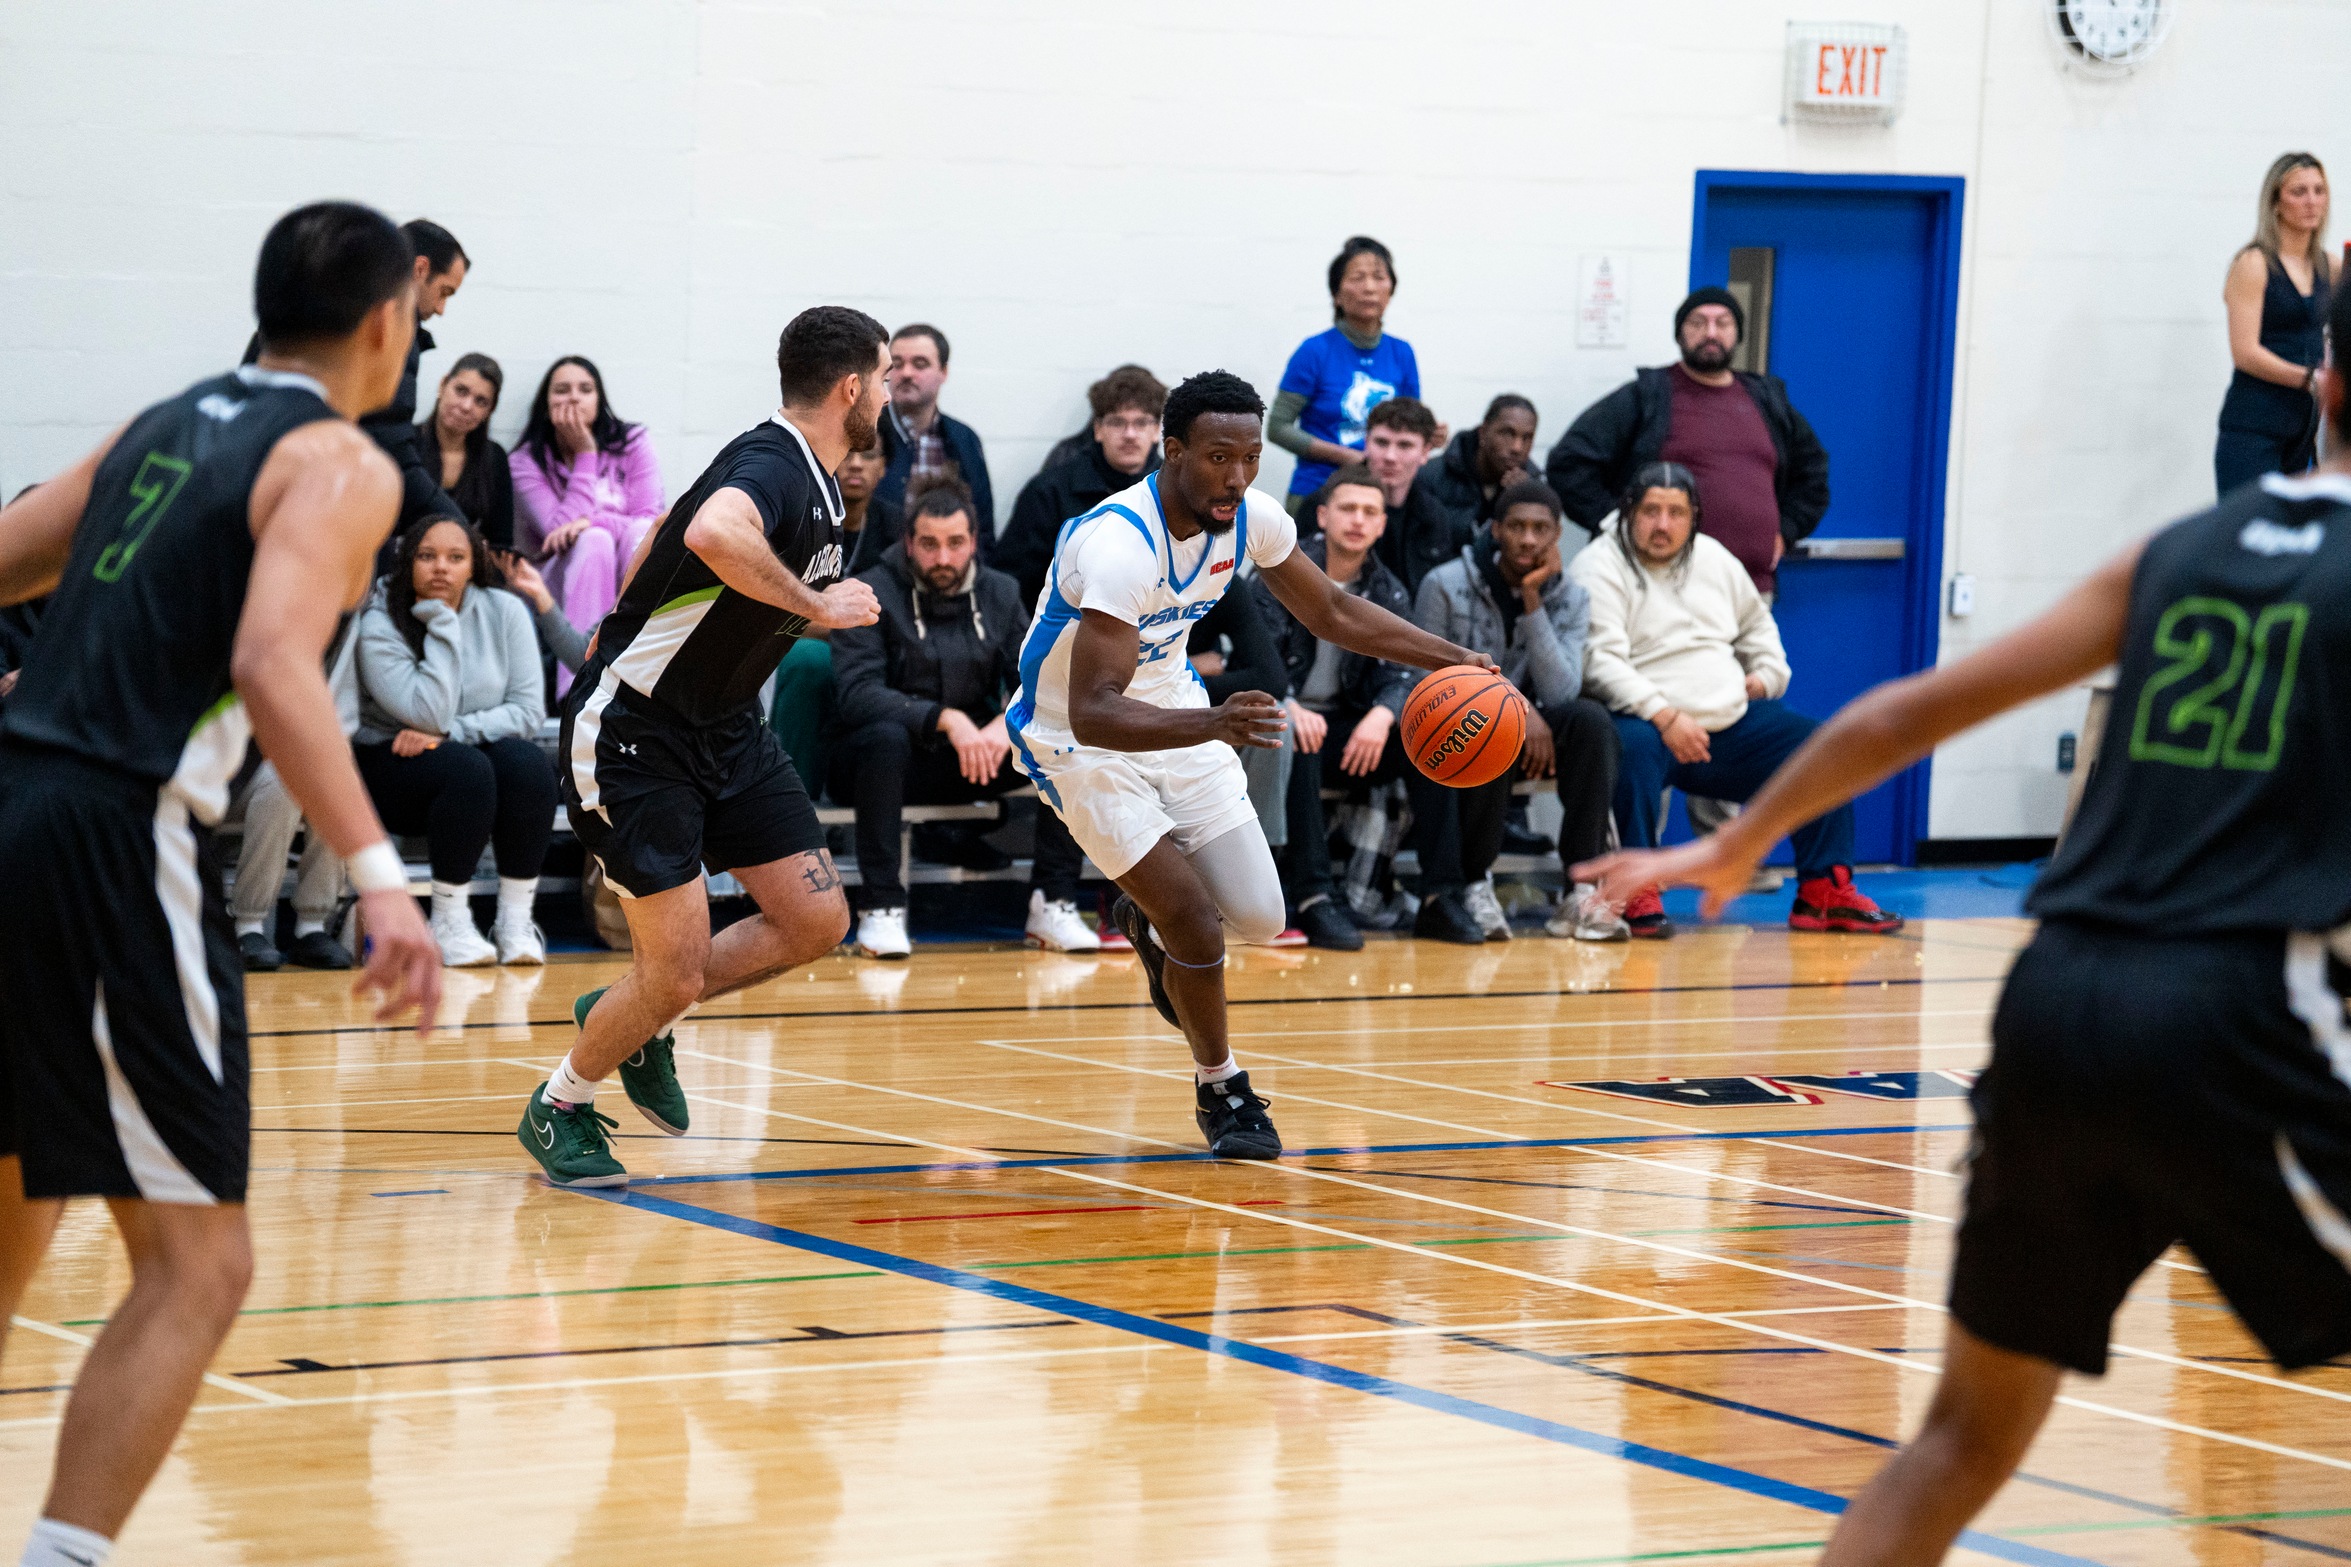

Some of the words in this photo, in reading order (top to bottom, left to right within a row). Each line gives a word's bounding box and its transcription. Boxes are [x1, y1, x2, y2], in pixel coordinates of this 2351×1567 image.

[1816, 44, 1888, 96] EXIT
[93, 451, 193, 583] 7
[1138, 599, 1218, 632] USKIES
[2128, 595, 2310, 771] 21
[1422, 708, 1491, 771] Wilson
